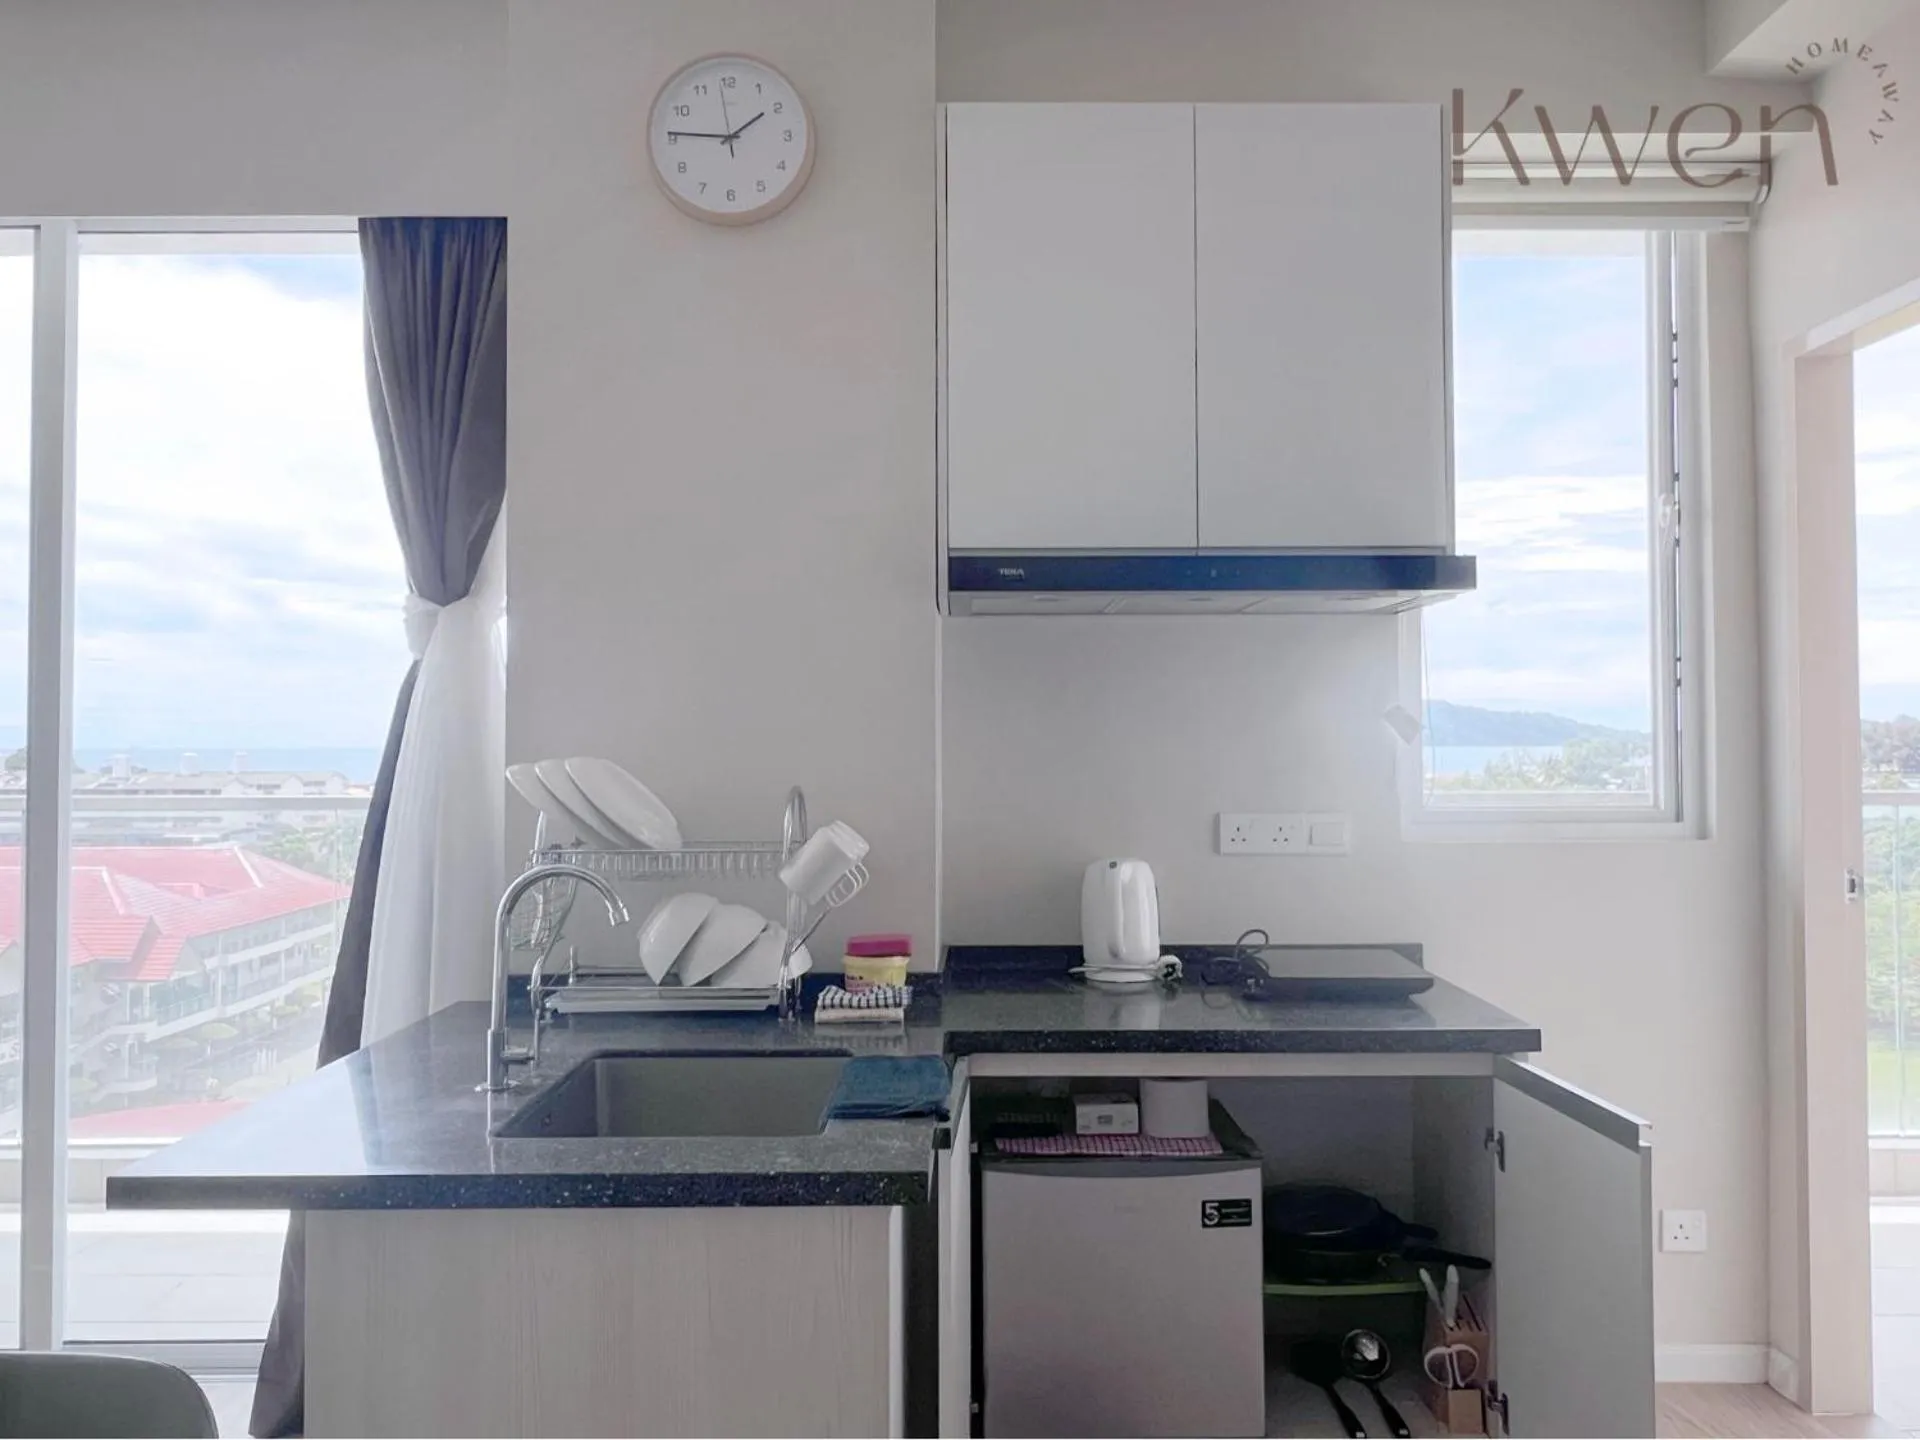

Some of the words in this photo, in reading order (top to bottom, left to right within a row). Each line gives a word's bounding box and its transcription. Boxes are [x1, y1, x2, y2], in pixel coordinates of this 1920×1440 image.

[721, 77, 736, 88] 12
[694, 85, 707, 95] 11
[755, 83, 762, 94] 1
[673, 105, 690, 117] 10
[773, 102, 783, 114] 2
[783, 130, 793, 142] 3
[678, 162, 687, 173] 8
[776, 160, 786, 171] 4
[699, 182, 707, 194] 7
[756, 181, 766, 192] 5
[726, 189, 736, 201] 6
[1204, 1202, 1220, 1225] 5
